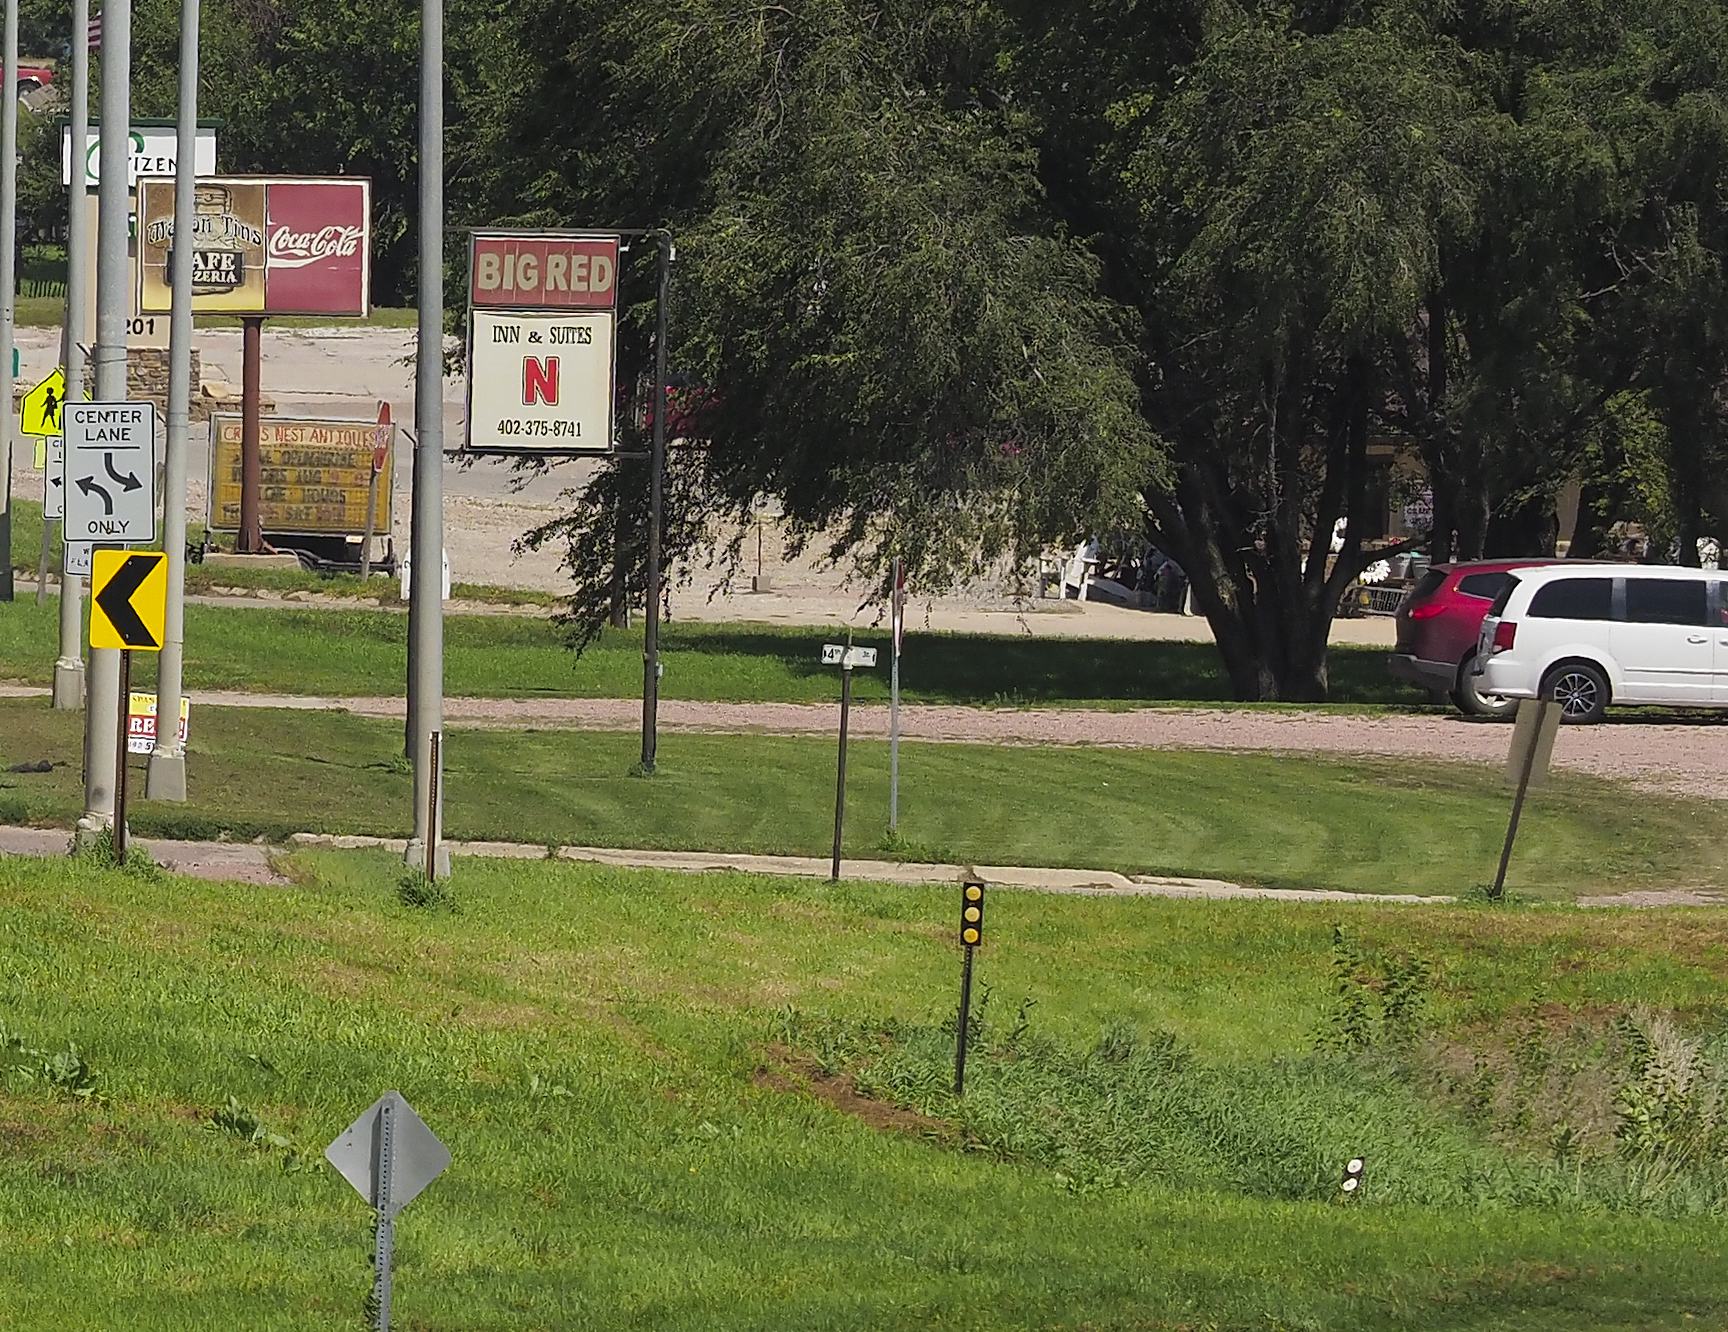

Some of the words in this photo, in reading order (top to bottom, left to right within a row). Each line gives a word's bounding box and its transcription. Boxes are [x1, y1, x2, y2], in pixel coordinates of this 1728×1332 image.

[269, 225, 364, 257] Coca-Cola
[193, 252, 236, 270] AFE
[478, 253, 538, 291] BIG
[545, 254, 613, 293] RED
[493, 325, 520, 344] INN
[528, 331, 543, 344] &
[549, 326, 592, 345] SUITES
[522, 356, 560, 406] N
[75, 410, 142, 424] CENTER
[85, 428, 132, 441] LANE
[275, 426, 306, 443] NEST
[497, 419, 581, 437] 402-375-8741
[87, 521, 130, 535] ONLY
